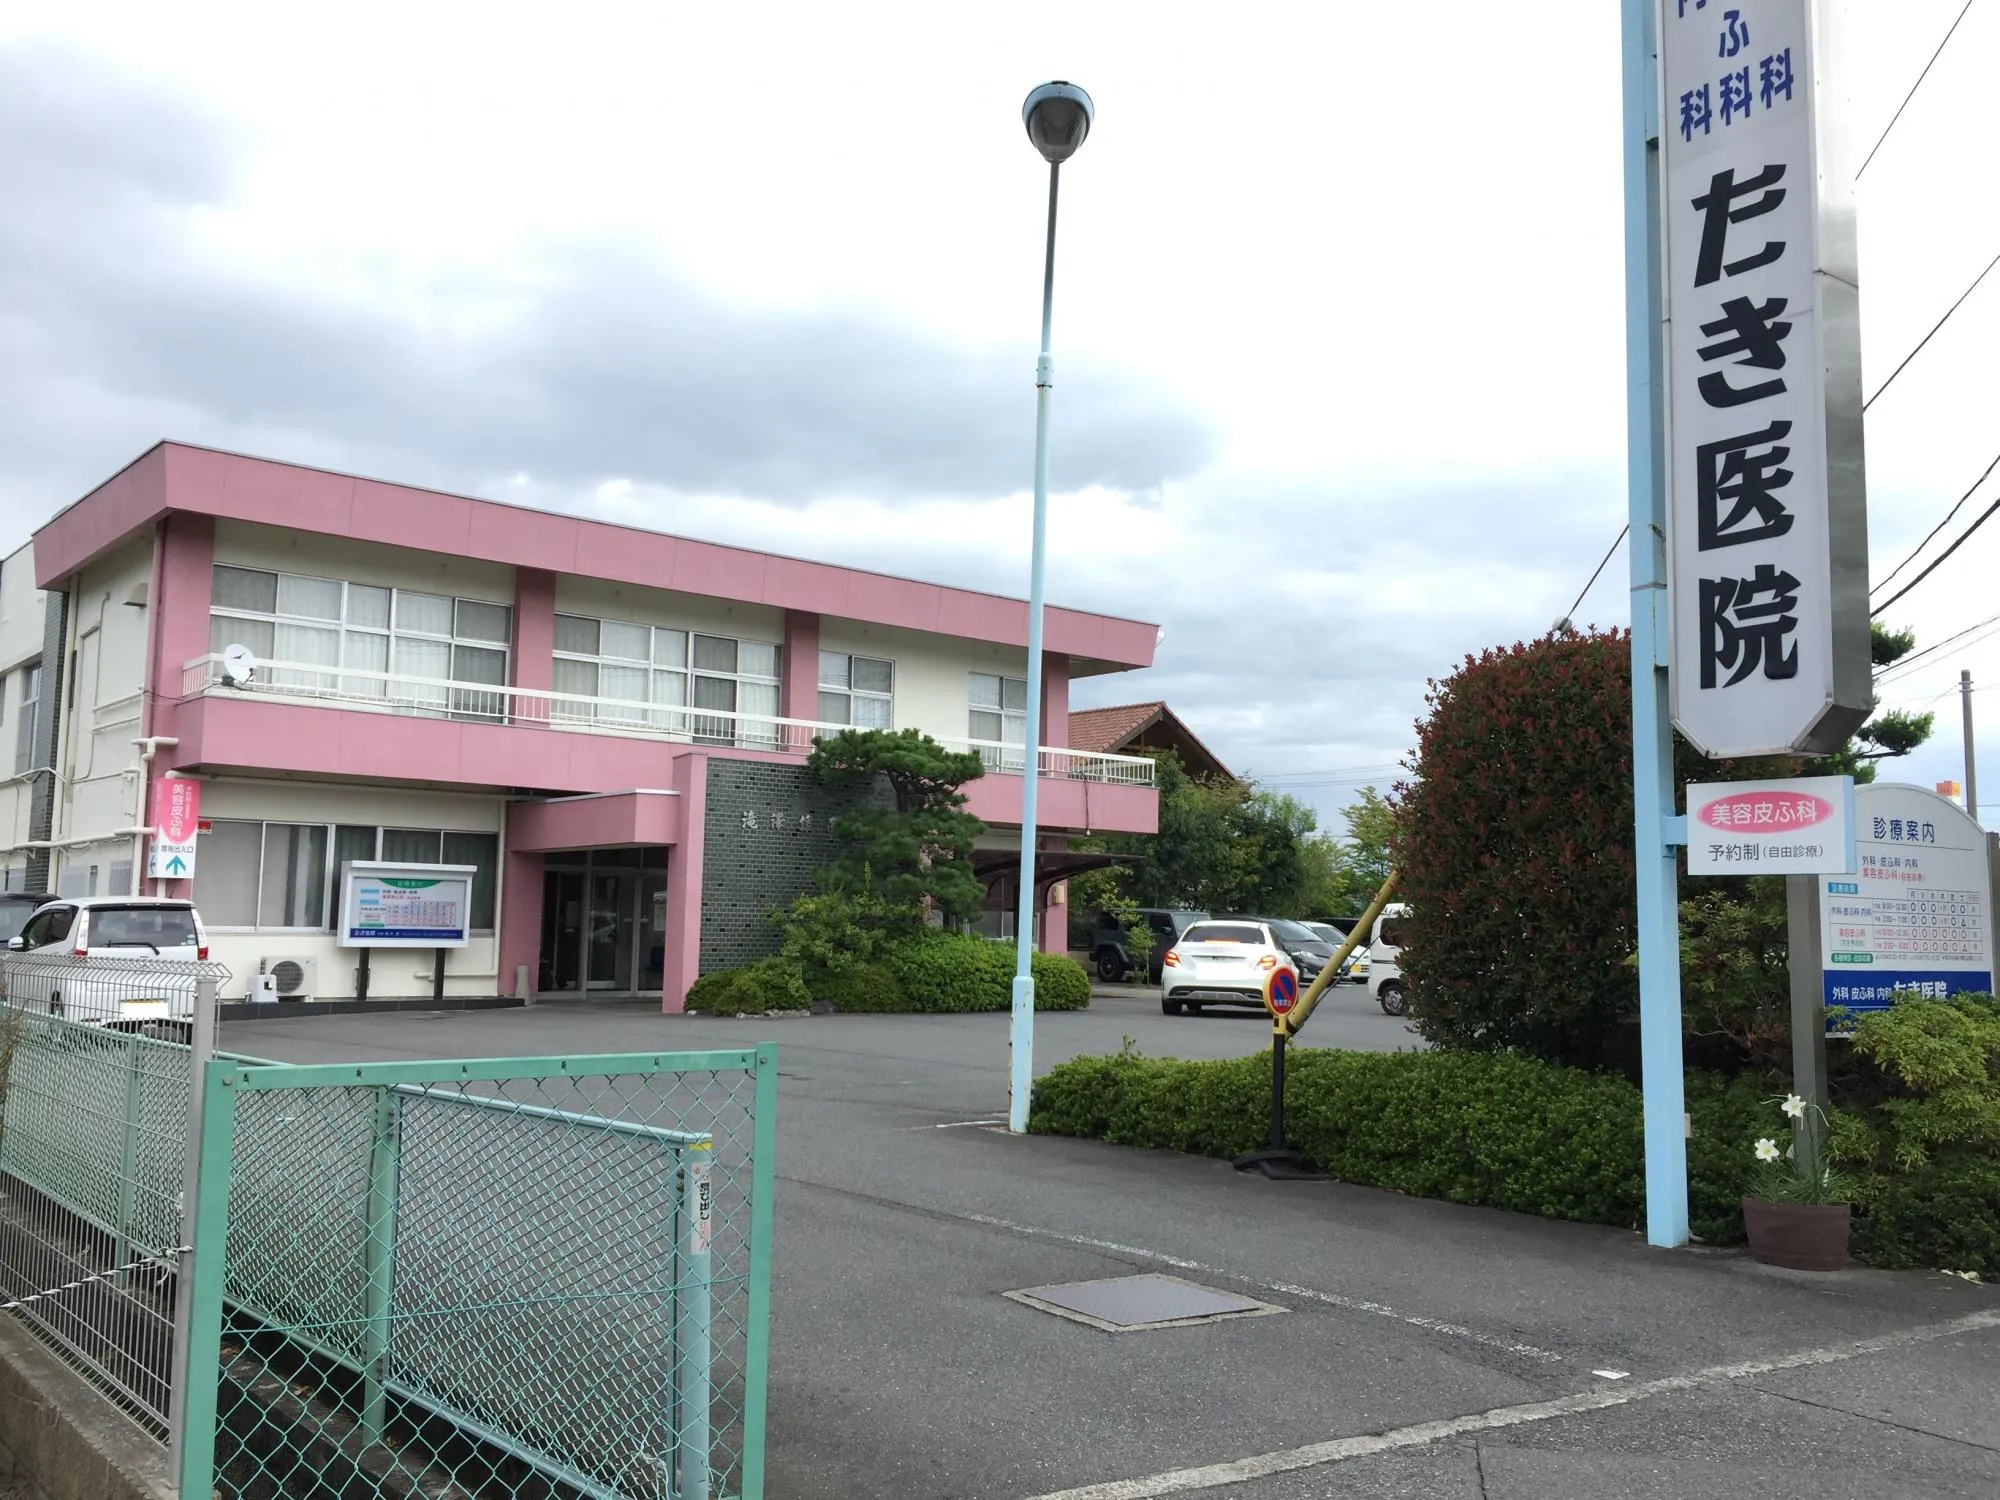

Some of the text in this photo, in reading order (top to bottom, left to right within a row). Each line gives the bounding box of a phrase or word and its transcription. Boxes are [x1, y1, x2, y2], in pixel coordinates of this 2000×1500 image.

[1690, 163, 1801, 690] たき医院
[1711, 800, 1818, 826] 美容皮ふ科
[1873, 817, 1935, 844] 診療案内
[1832, 986, 1849, 1000] 外科
[1851, 986, 1875, 1000] 皮ふ科
